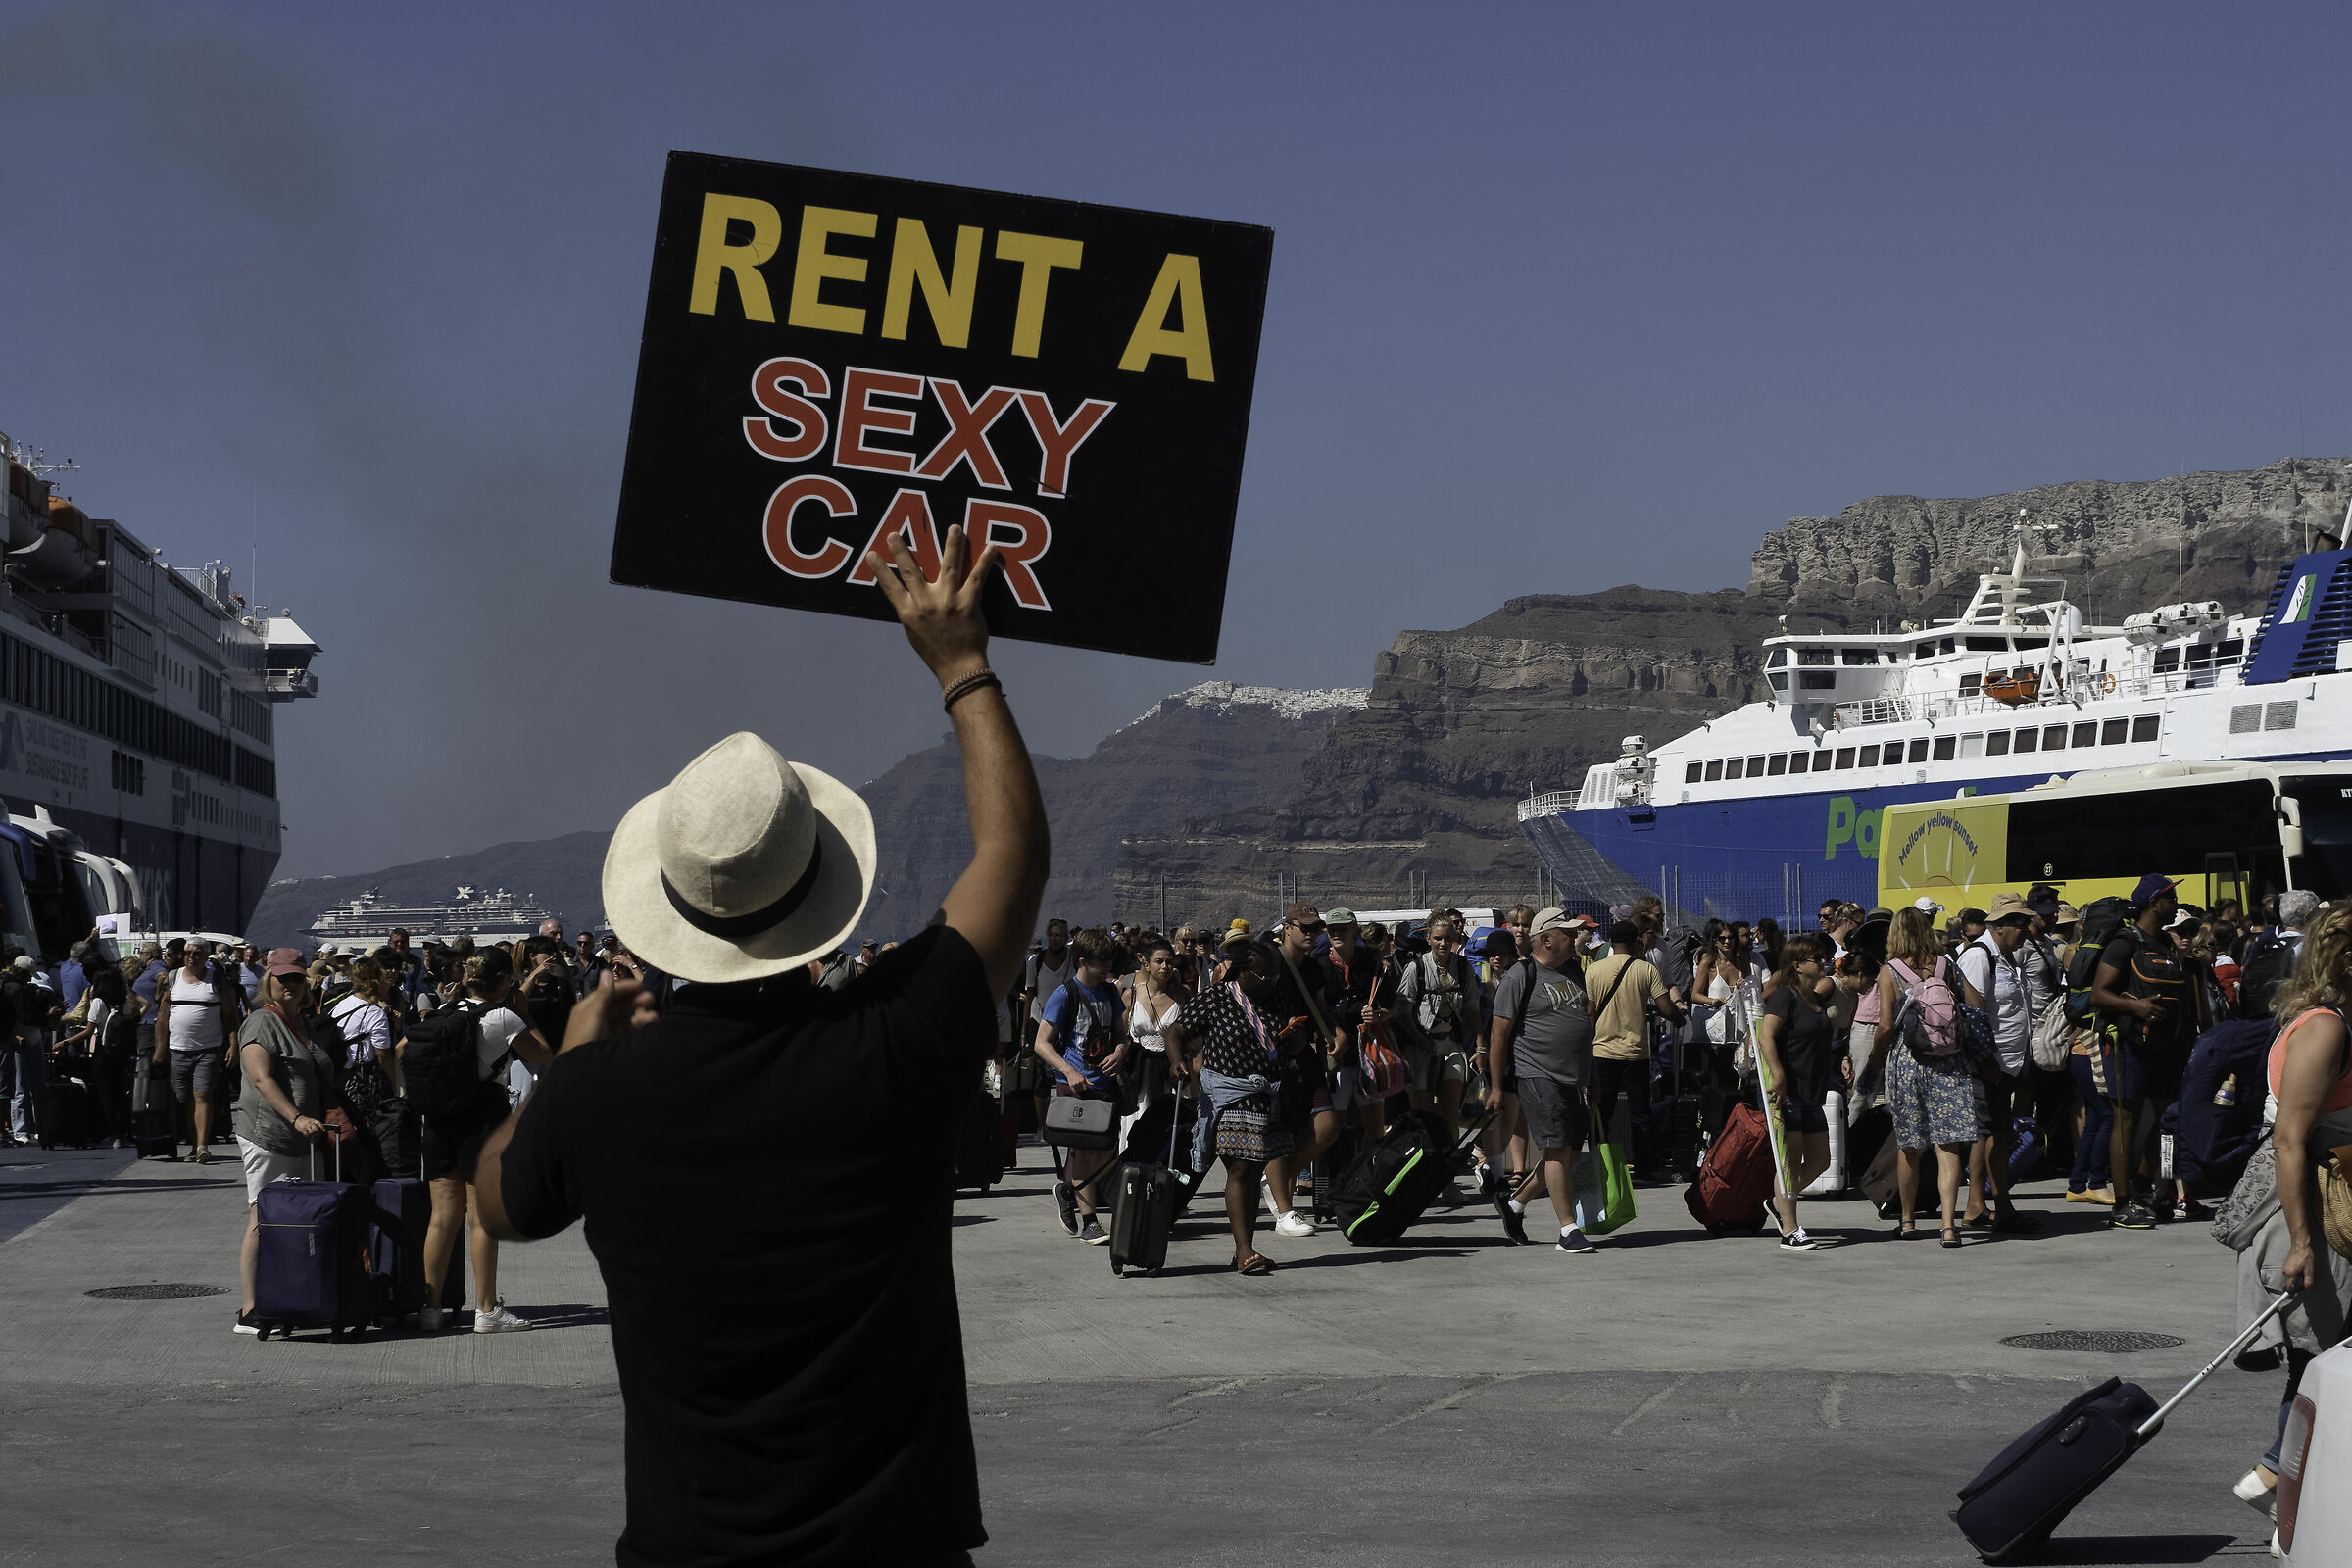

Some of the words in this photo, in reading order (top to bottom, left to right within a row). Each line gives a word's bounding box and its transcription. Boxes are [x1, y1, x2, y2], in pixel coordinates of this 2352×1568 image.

[689, 192, 1084, 358] RENT
[1117, 253, 1215, 382] A
[743, 356, 1117, 499] SEXY
[762, 474, 1052, 612] CAR
[1898, 822, 1926, 866] Mellow
[1927, 811, 1953, 836] yellow
[1953, 819, 1978, 858] sunset
[1544, 980, 1584, 1011] Duff
